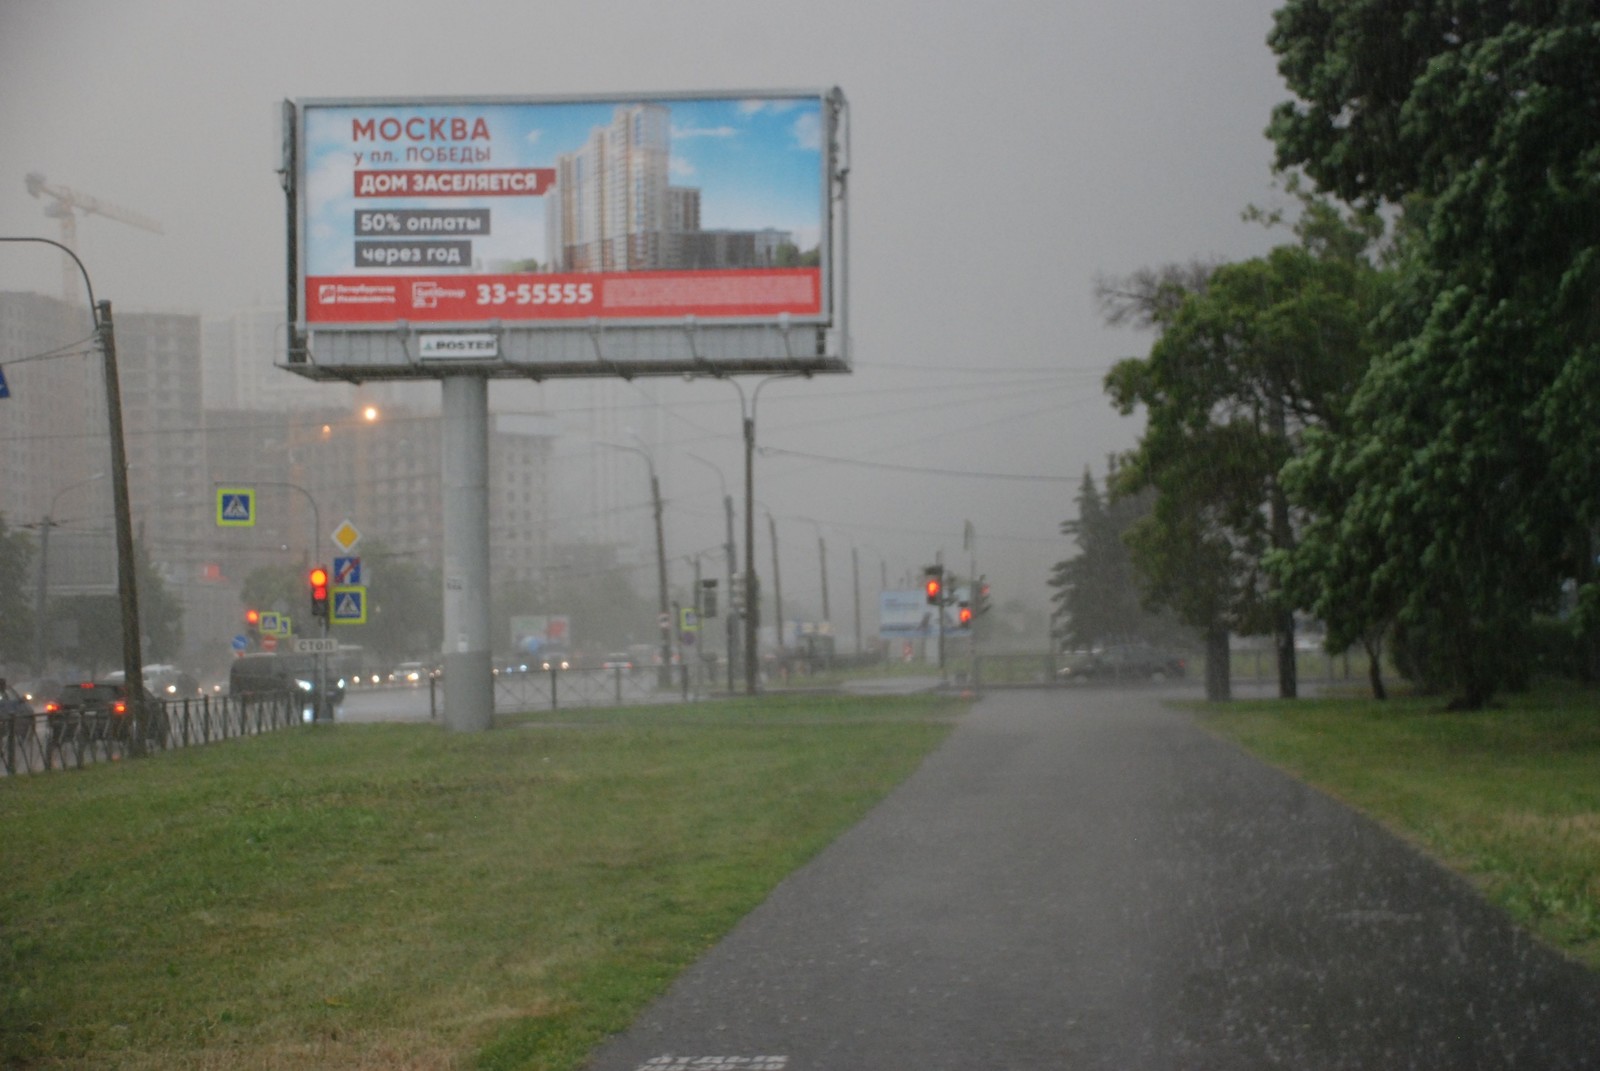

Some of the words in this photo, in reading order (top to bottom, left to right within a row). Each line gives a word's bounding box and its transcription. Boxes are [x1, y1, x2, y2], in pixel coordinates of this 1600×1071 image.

[352, 118, 490, 141] МОСКВА
[353, 150, 363, 166] у
[370, 150, 398, 162] пл.
[406, 146, 491, 164] ПОБЕДЫ
[360, 174, 407, 194] ДОМ
[413, 173, 537, 192] ЗАСЕЛЯЕТСЯ
[361, 213, 401, 231] 50%
[407, 216, 481, 231] оплаты
[362, 247, 421, 265] через
[427, 246, 461, 263] год
[476, 283, 593, 305] 33-55555
[298, 640, 333, 651] СТОП
